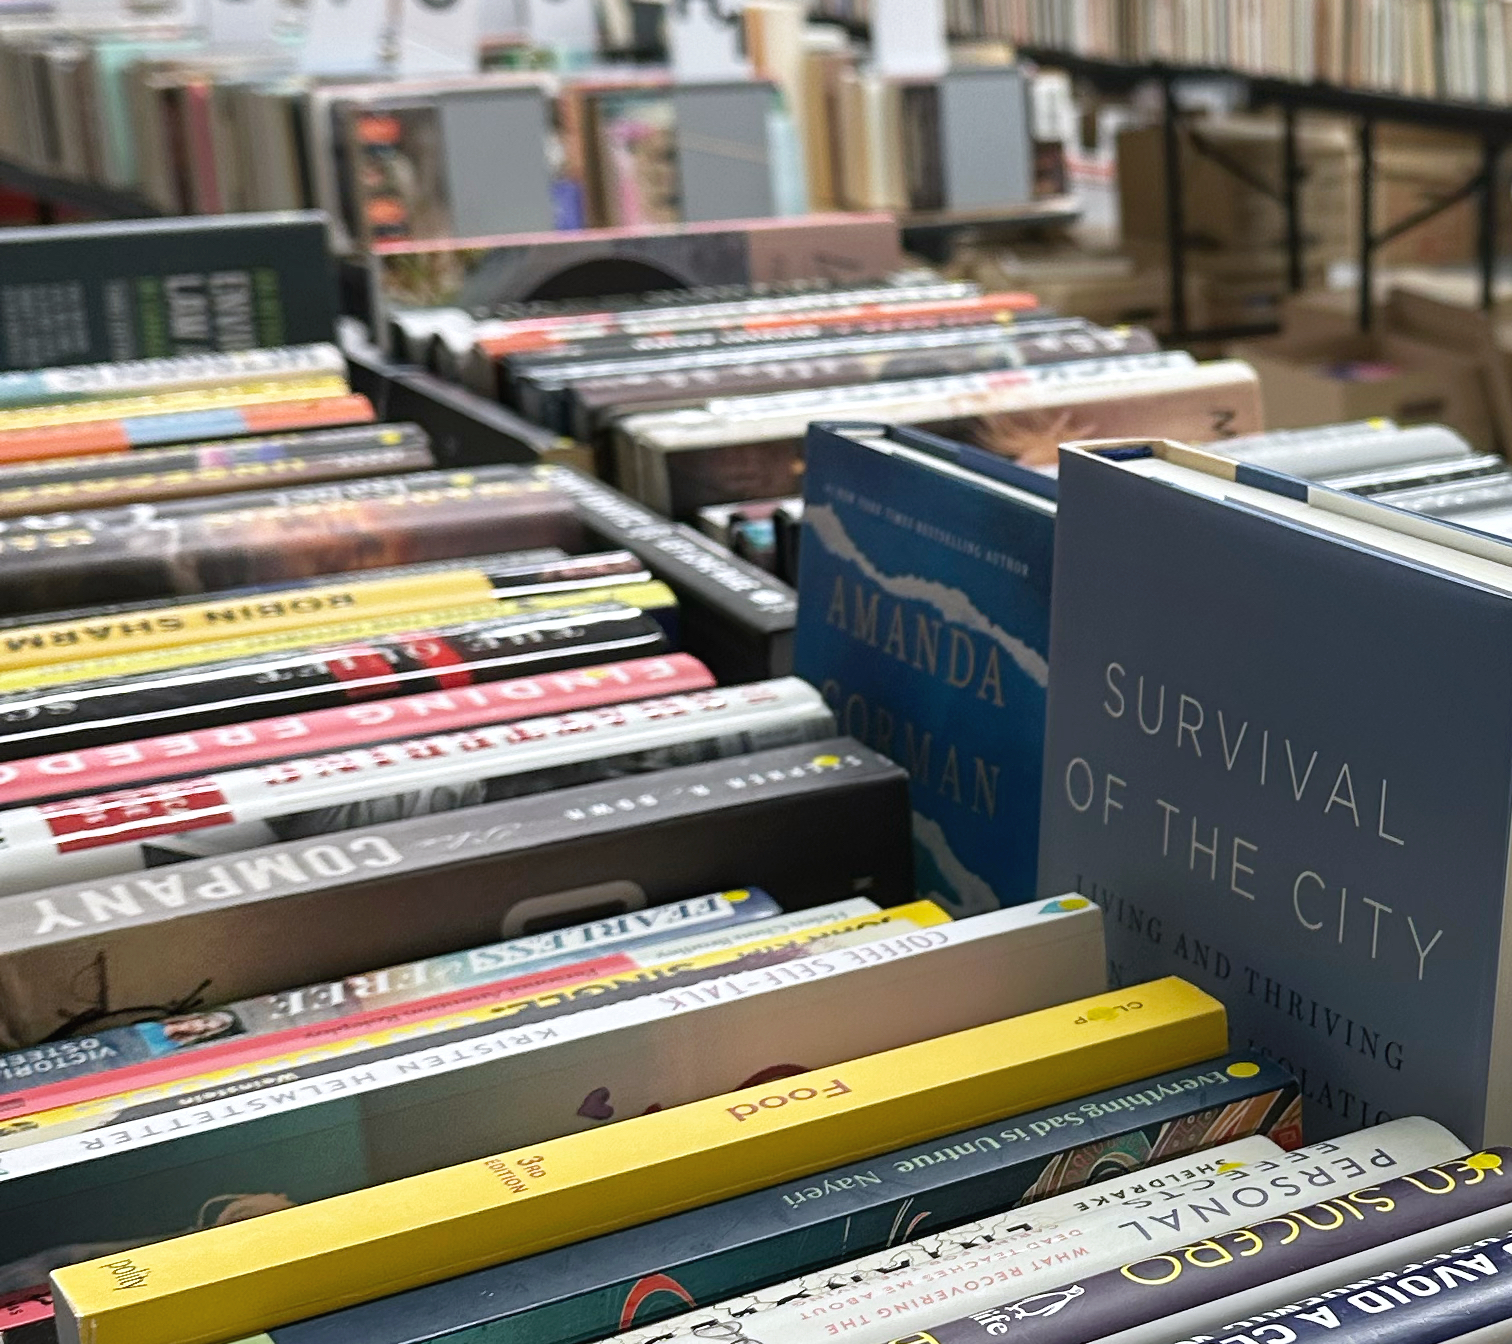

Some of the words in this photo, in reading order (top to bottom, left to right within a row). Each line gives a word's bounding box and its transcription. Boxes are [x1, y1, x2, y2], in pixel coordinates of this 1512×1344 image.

[198, 589, 357, 643] ROBIN
[825, 572, 1006, 710] AMANDA
[348, 655, 682, 730] FINDING
[817, 677, 1001, 821] GORMAN
[1102, 660, 1406, 847] SURVIVAL
[34, 835, 404, 937] COMPANY
[1064, 757, 1128, 826] OF
[1156, 797, 1258, 902] THE
[1294, 869, 1445, 982] CITY
[468, 895, 726, 972] FEARLESS
[833, 928, 950, 971] COFFEE
[269, 958, 430, 1019] FREE
[661, 945, 837, 1017] SELF-TALK
[1075, 874, 1163, 945] LIVING
[1173, 933, 1231, 981] AND
[1244, 966, 1406, 1071] THRIVING
[1072, 999, 1145, 1027] CLP
[399, 1026, 561, 1073] KRISTEN
[79, 1061, 380, 1154] HELMSTETTER
[726, 1078, 854, 1124] Food
[1030, 1106, 1076, 1135] Sad
[1078, 1070, 1230, 1119] Everything
[894, 1134, 984, 1176] Untrue
[1000, 1126, 1027, 1145] is
[482, 1156, 529, 1197] EDITION
[517, 1154, 547, 1182] 3RD
[780, 1166, 885, 1211] Nayeri
[1116, 1148, 1399, 1245] PERSONAL
[1032, 1246, 1090, 1272] WHAT
[1119, 1189, 1399, 1287] SINCERO
[105, 1258, 148, 1292] polity
[876, 1266, 1024, 1320] RECOVERING
[1348, 1238, 1498, 1315] AVOID
[824, 1314, 870, 1336] THE
[1301, 1300, 1344, 1331] A
